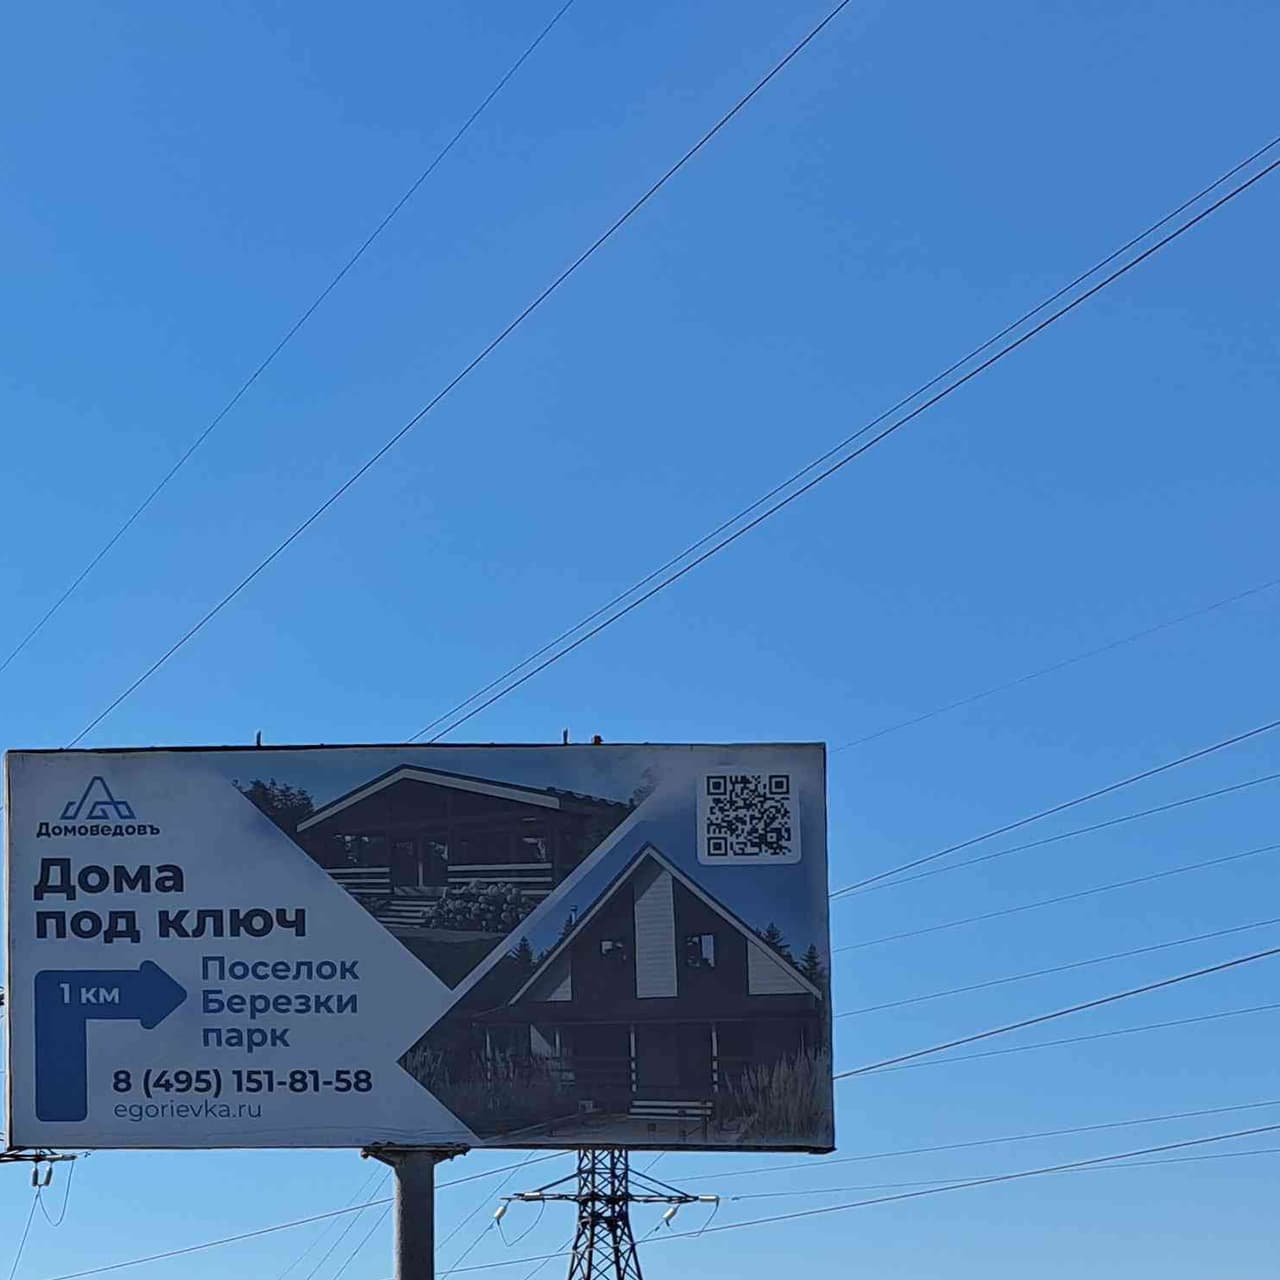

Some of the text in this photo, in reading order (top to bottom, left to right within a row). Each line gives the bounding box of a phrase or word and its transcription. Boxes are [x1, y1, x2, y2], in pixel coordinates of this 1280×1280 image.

[36, 822, 161, 838] Домоведовъ
[33, 857, 185, 901] Дома
[35, 908, 307, 944] под ключ
[201, 955, 360, 981] Поселок
[59, 982, 120, 1005] 1 км
[201, 989, 358, 1020] Березки
[202, 1026, 291, 1053] парк
[112, 1069, 373, 1099] 8 (495) 151-81-58
[113, 1099, 262, 1122] egorievka.ru
